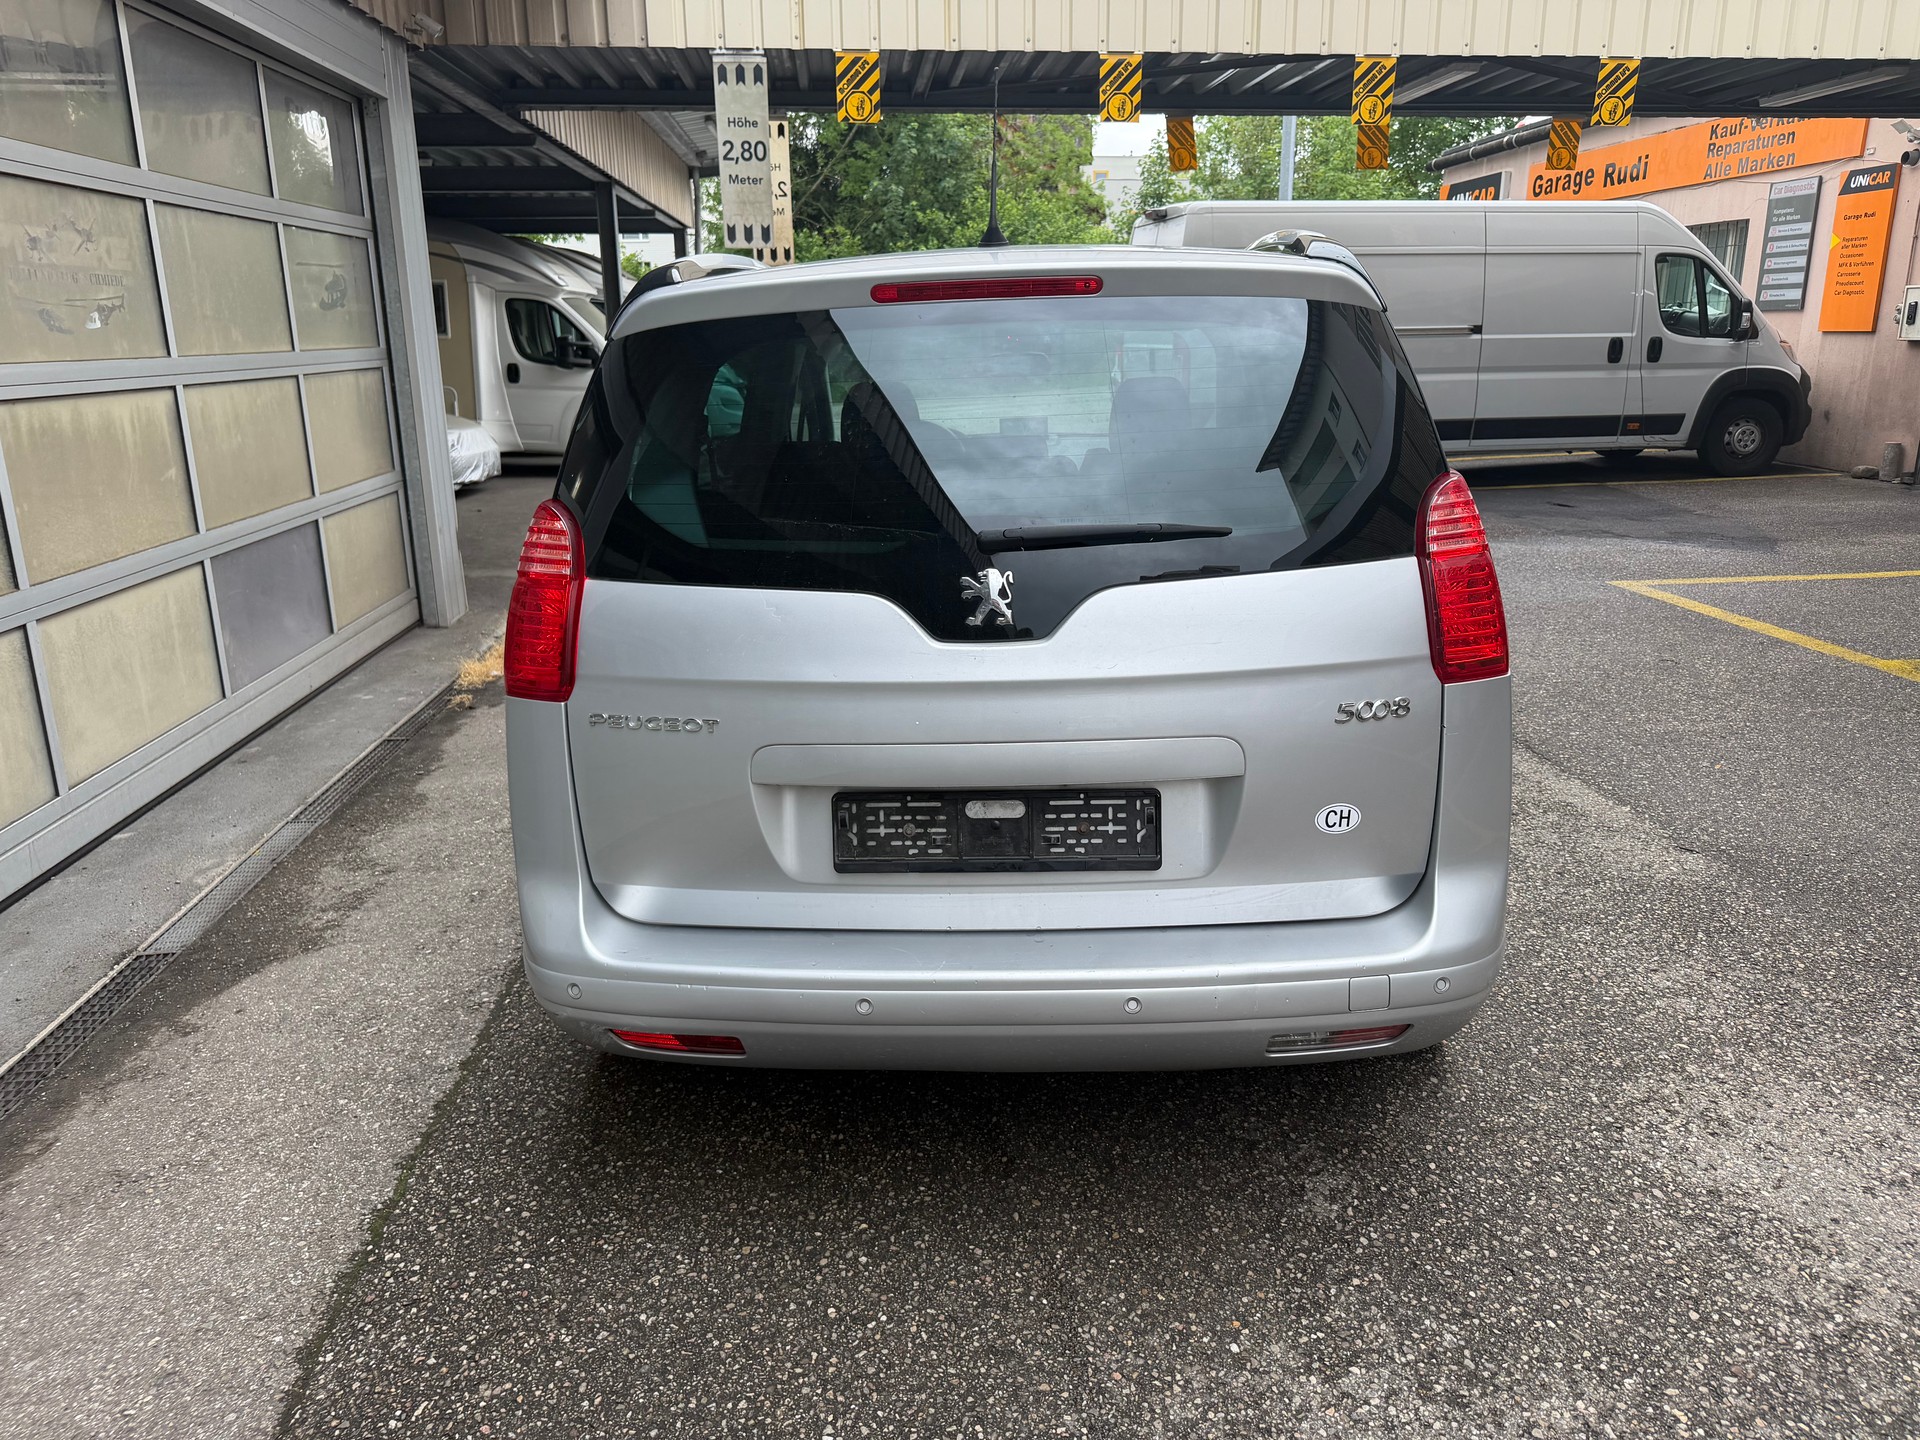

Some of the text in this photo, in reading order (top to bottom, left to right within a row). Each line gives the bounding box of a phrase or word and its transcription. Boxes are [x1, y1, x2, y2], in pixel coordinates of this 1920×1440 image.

[728, 117, 758, 128] Höhe
[722, 140, 768, 164] 2,80
[1706, 131, 1796, 160] Reparaturen
[1532, 168, 1594, 198] Garage
[1603, 154, 1650, 188] Rudi
[1703, 152, 1796, 180] Alle Marken
[728, 174, 763, 185] Meter
[1774, 181, 1815, 196] Car Diagnostic
[1844, 213, 1862, 221] Garage
[1842, 235, 1868, 243] Reparaturen
[1334, 696, 1411, 725] 5008
[588, 712, 720, 733] PEUGEOT
[1324, 809, 1353, 828] CH
